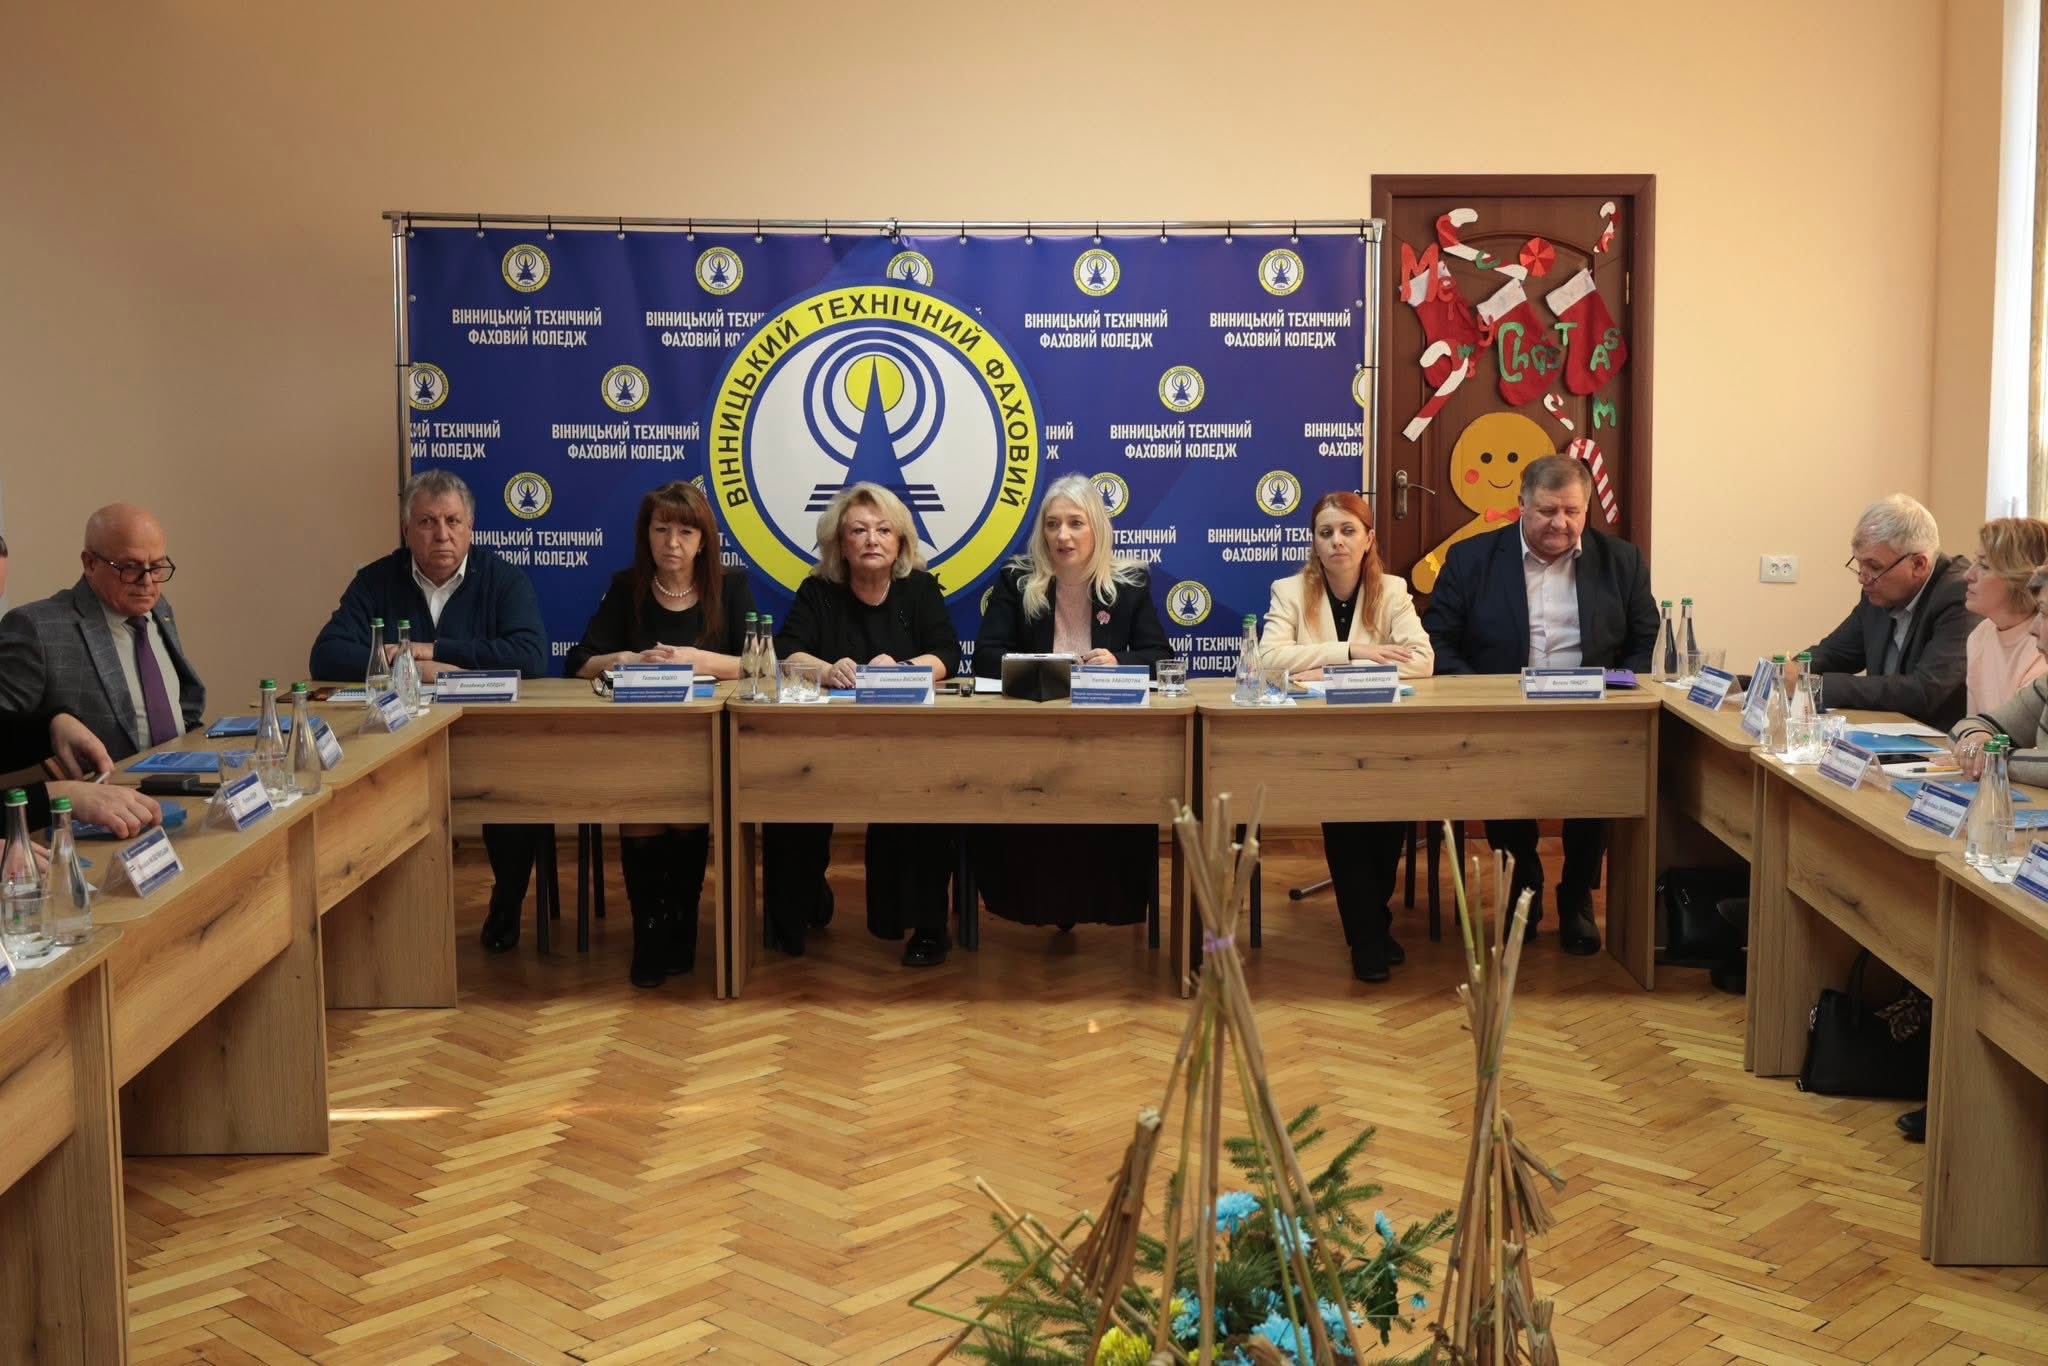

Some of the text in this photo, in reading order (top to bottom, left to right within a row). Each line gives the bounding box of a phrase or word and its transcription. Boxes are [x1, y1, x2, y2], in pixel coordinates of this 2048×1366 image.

[453, 307, 601, 328] ВІННИЦЬКИЙ ТЕХНІЧНИЙ
[647, 309, 724, 331] ВІННИЦЬКИЙ
[1025, 309, 1167, 330] ВІННИЦЬКИЙ ТЕХНІЧНИЙ
[1210, 309, 1350, 330] ВІННИЦЬКИЙ ТЕХНІЧНИЙ
[469, 326, 587, 347] ФАХОВИЙ КОЛЕДЖ
[662, 327, 720, 347] ФАХОВИЙ
[1040, 327, 1153, 349] ФАХОВИЙ КОЛЕДЖ
[1225, 327, 1336, 348] ФАХОВИЙ КОЛЕДЖ
[717, 293, 1030, 508] ВІННИЦЬКИЙ ТЕХНІЧНИЙ ФАХОВИЙ
[433, 419, 501, 438] ТЕХНІЧНИЙ
[552, 421, 699, 443] ВІННИЦЬКИЙ ТЕХНІЧНИЙ
[1111, 420, 1251, 443] ВІННИЦЬКИЙ ТЕХНІЧНИЙ
[431, 443, 486, 460] КОЛЕДЖ
[568, 439, 684, 462] ФАХОВИЙ КОЛЕДЖ
[1125, 439, 1237, 459] ФАХОВИЙ КОЛЕДЖ
[471, 528, 603, 547] НИЦЬКИЙ ТЕХНІЧНИЙ
[1113, 525, 1177, 544] ТЕХНІЧНИЙ
[1208, 524, 1282, 545] ВІННИЦЬКИЙ
[534, 550, 588, 568] КОЛЕДЖ
[1222, 543, 1278, 562] ФАХОВИЙ
